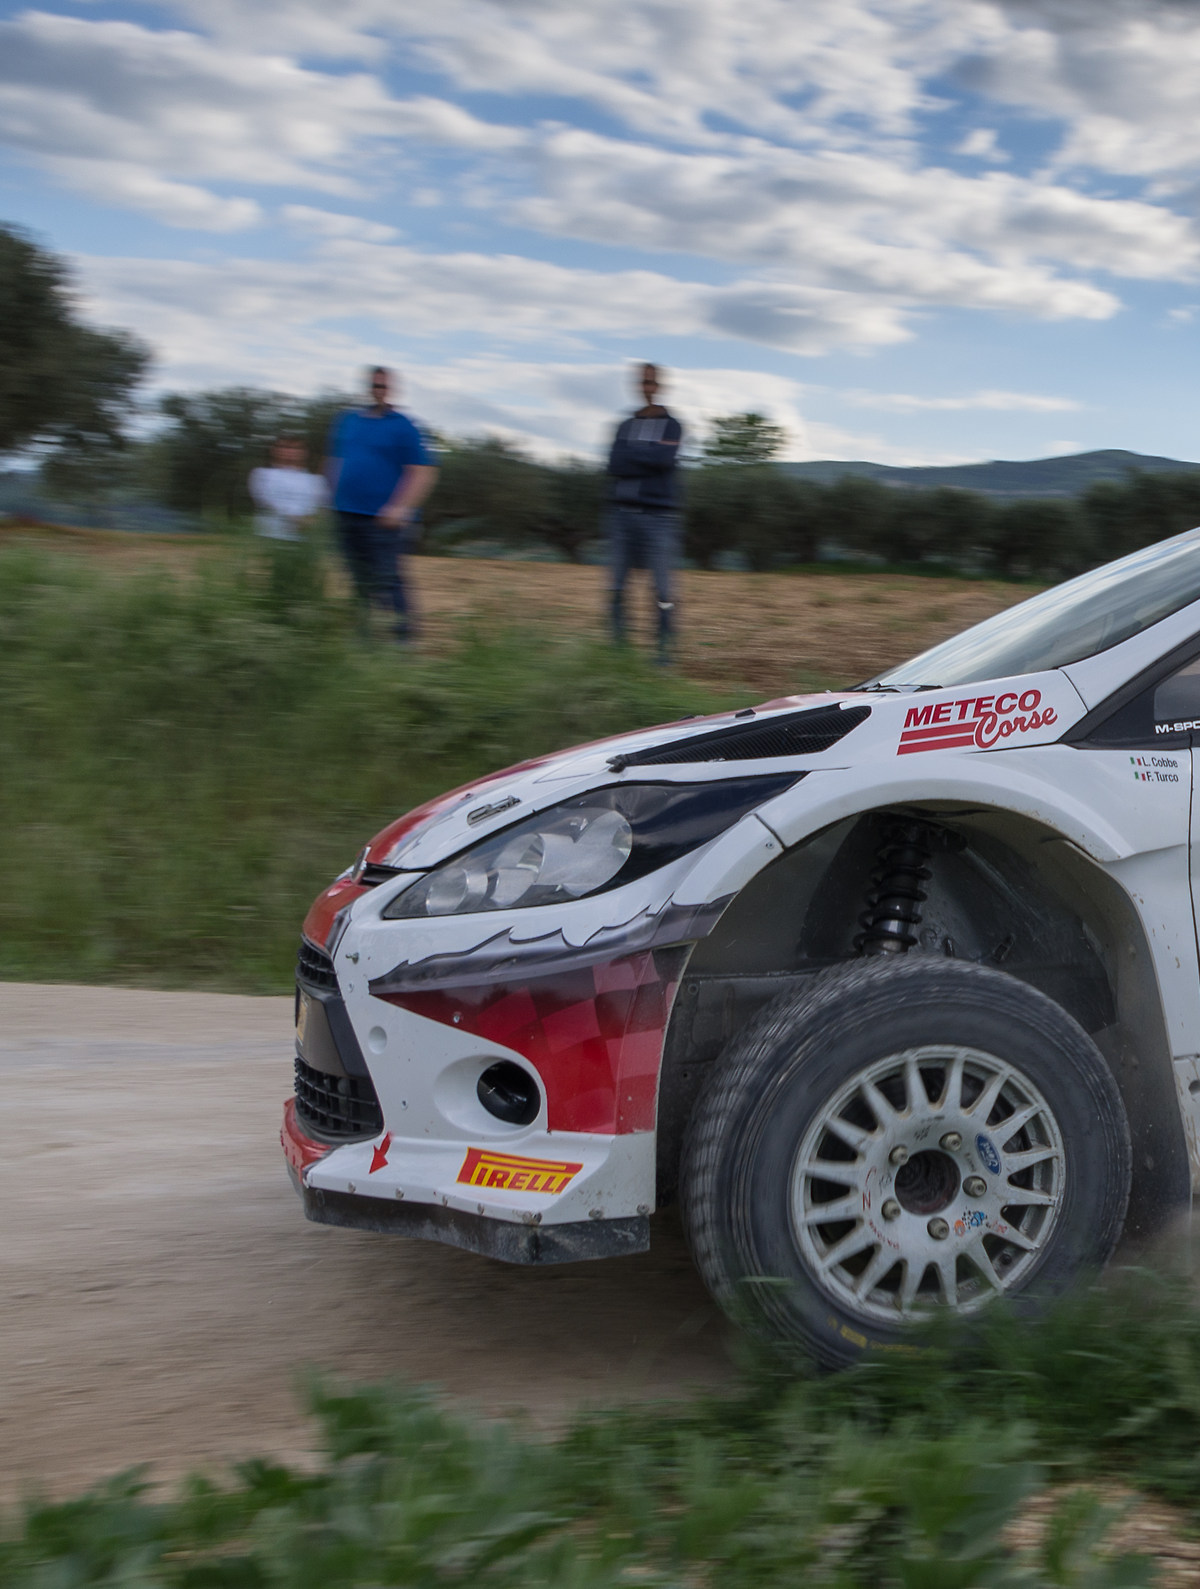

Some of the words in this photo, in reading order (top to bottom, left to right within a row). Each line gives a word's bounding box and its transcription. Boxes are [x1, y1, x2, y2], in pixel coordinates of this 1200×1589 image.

[904, 689, 1042, 728] METECO
[973, 706, 1058, 749] Corse
[1141, 756, 1151, 767] L.
[1151, 757, 1178, 768] Cobbe
[1146, 771, 1154, 782] F.
[1154, 771, 1179, 782] Turco
[456, 1147, 584, 1194] PIRELLI
